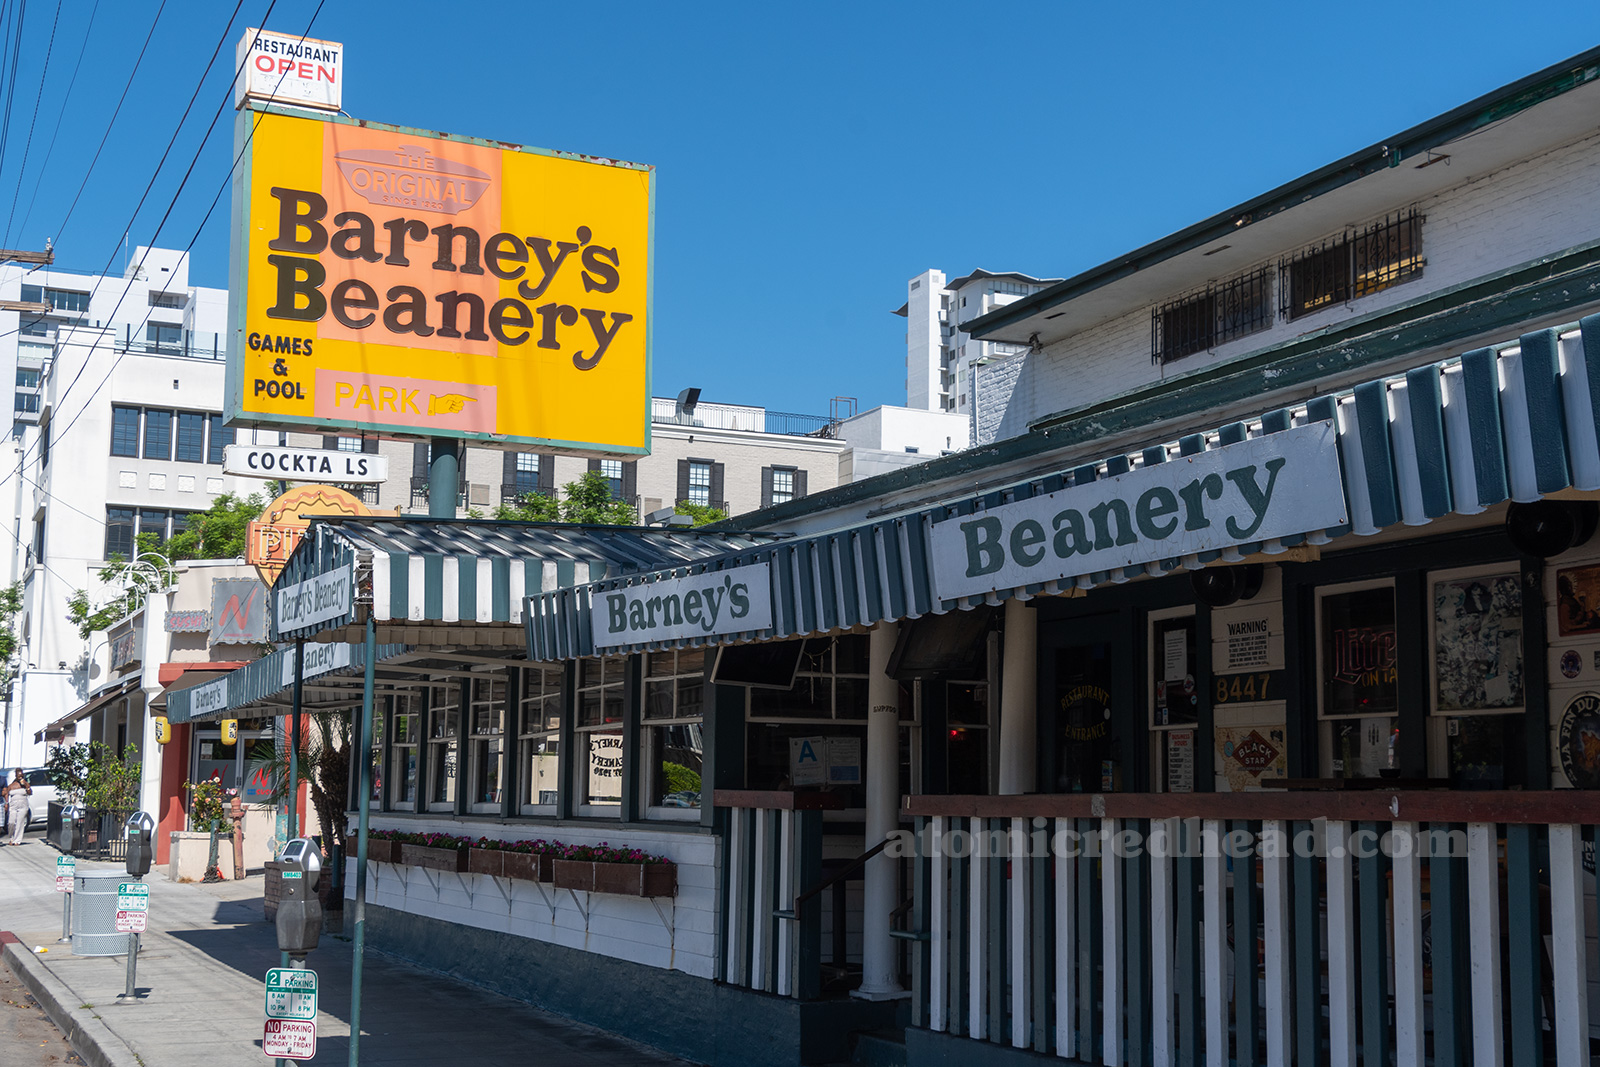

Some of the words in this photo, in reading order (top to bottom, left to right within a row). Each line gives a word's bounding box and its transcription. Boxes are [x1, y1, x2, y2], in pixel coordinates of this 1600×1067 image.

[255, 38, 338, 63] RESTAURANT
[255, 54, 335, 83] OPEN
[394, 153, 434, 170] THE
[351, 167, 473, 204] ORIGINAL
[383, 195, 417, 206] SINCE
[268, 186, 620, 300] Barney's
[266, 254, 633, 371] Beanery
[248, 332, 313, 356] GAMES
[272, 358, 288, 376] &
[254, 379, 305, 399] POOL
[335, 381, 421, 415] PARK
[960, 457, 1286, 578] Beanery
[282, 584, 313, 623] Barney's
[314, 576, 346, 612] Beanery
[606, 575, 750, 634] Barney's
[170, 615, 202, 628] SUSHI
[1227, 619, 1267, 636] WARNING
[1216, 673, 1271, 703] 8447
[1361, 669, 1379, 688] ON
[195, 684, 222, 709] Barney's
[1060, 684, 1110, 712] RESTAURANT
[1574, 697, 1595, 713] DU
[1064, 721, 1108, 742] ENTRANCE
[1562, 709, 1577, 738] FIN
[799, 739, 817, 763] A
[1238, 742, 1272, 759] BLACK
[1245, 757, 1265, 765] STAR
[1561, 742, 1573, 767] LA
[120, 884, 126, 892] 2
[269, 972, 278, 984] 2
[285, 979, 314, 988] PARKING
[267, 1021, 280, 1032] NO
[282, 1023, 312, 1033] PARKING
